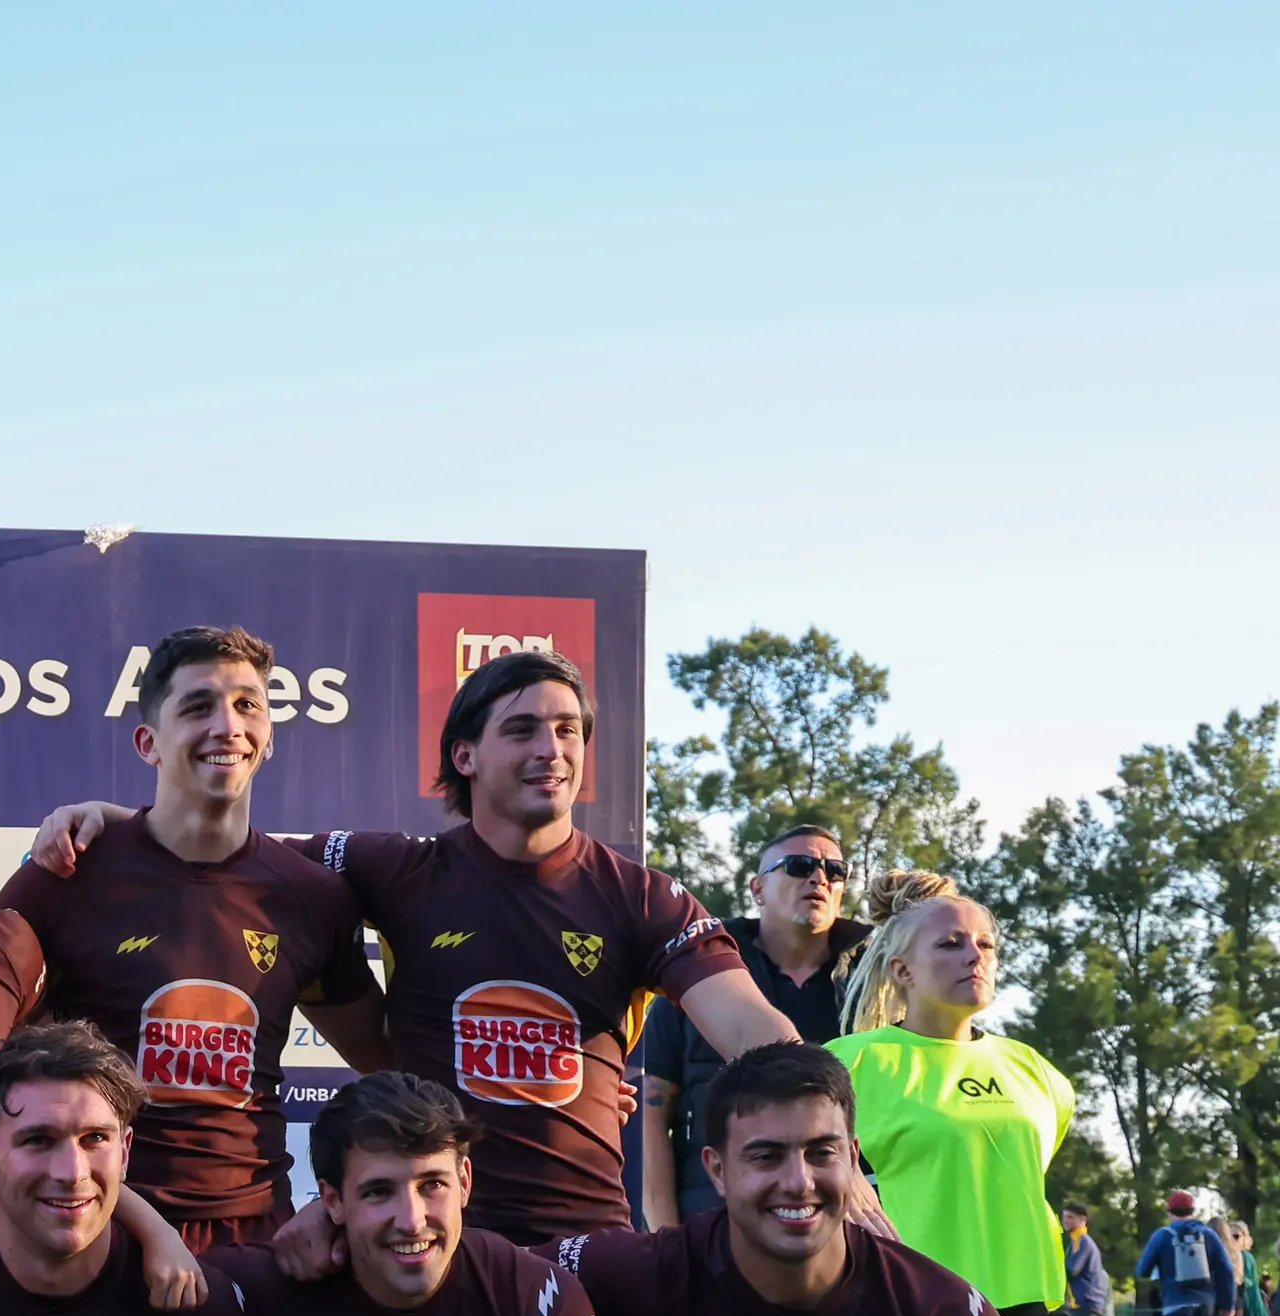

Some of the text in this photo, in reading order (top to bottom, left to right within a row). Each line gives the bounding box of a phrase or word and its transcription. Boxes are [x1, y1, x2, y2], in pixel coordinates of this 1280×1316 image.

[144, 1021, 255, 1054] BURGER
[459, 1018, 576, 1046] BURGER
[142, 1047, 250, 1089] KING
[461, 1042, 579, 1080] KING
[957, 1077, 1004, 1097] GM
